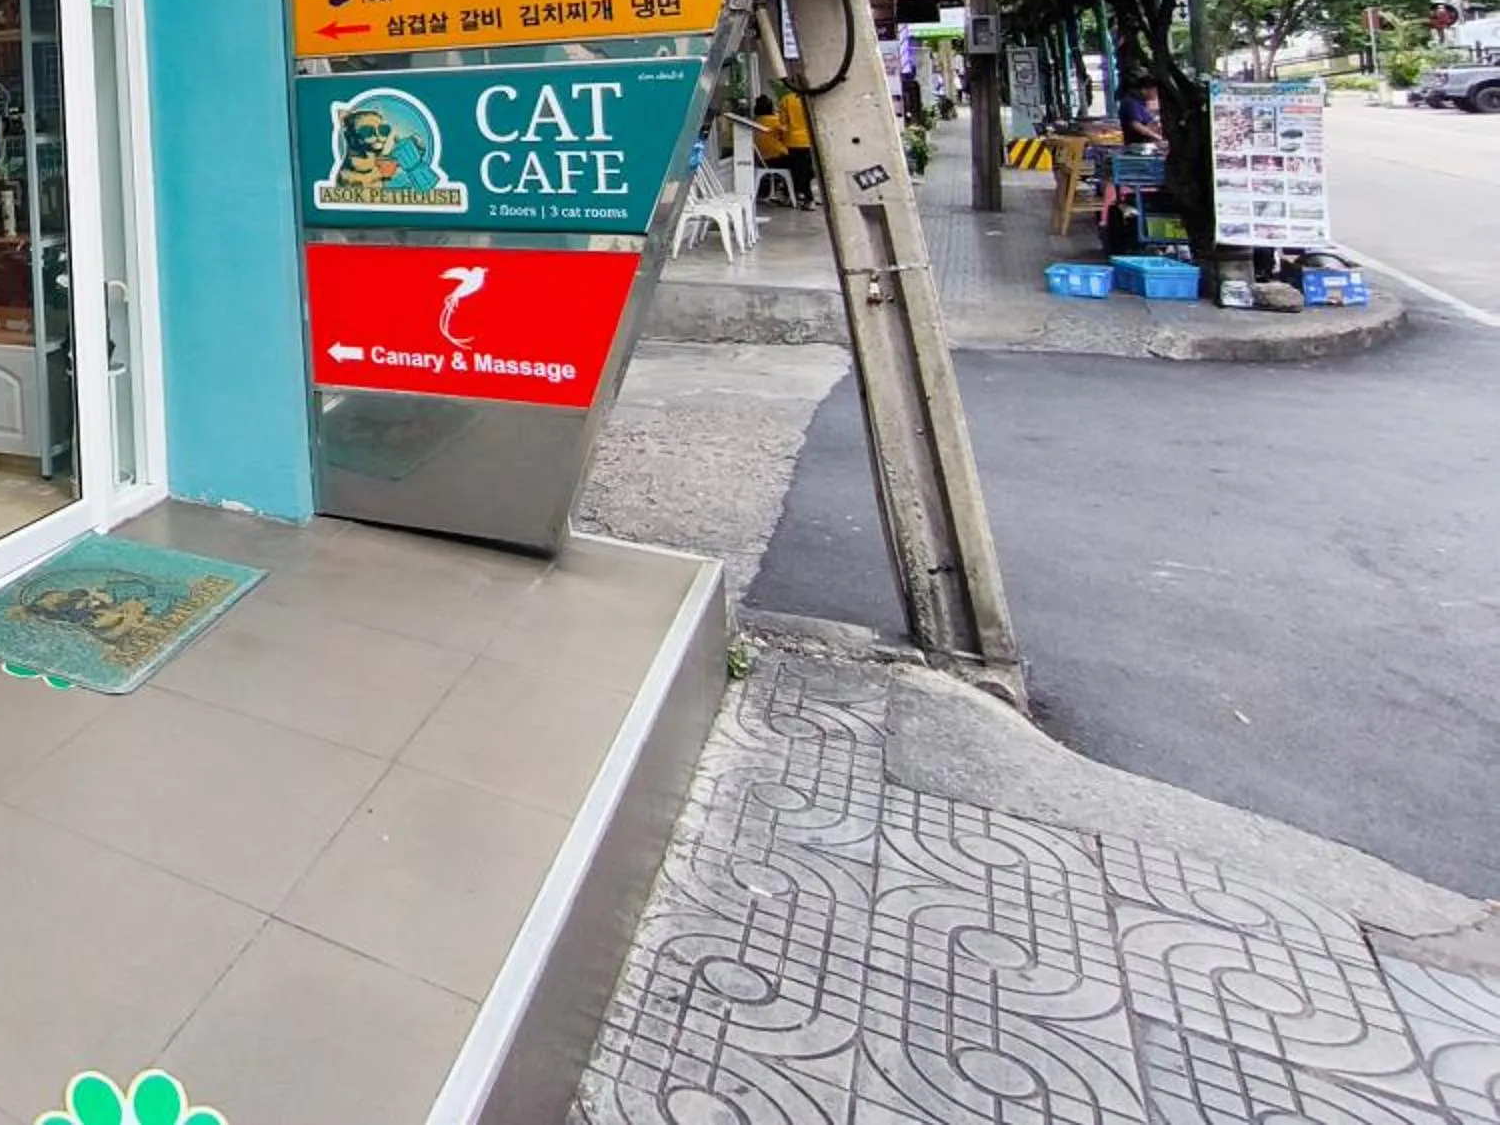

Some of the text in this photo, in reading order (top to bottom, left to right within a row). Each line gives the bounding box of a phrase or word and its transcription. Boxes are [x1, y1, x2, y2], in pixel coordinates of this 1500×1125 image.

[386, 12, 449, 36] 삼겹살
[460, 7, 502, 32] 갈비
[475, 82, 623, 143] CAT
[479, 150, 629, 194] CAFE
[322, 187, 365, 203] ASOK
[488, 204, 497, 216] 2
[500, 204, 537, 218] floors
[549, 205, 558, 217] 3
[561, 206, 581, 218] cat
[585, 207, 629, 219] rooms
[371, 345, 577, 383] Canary & Massage
